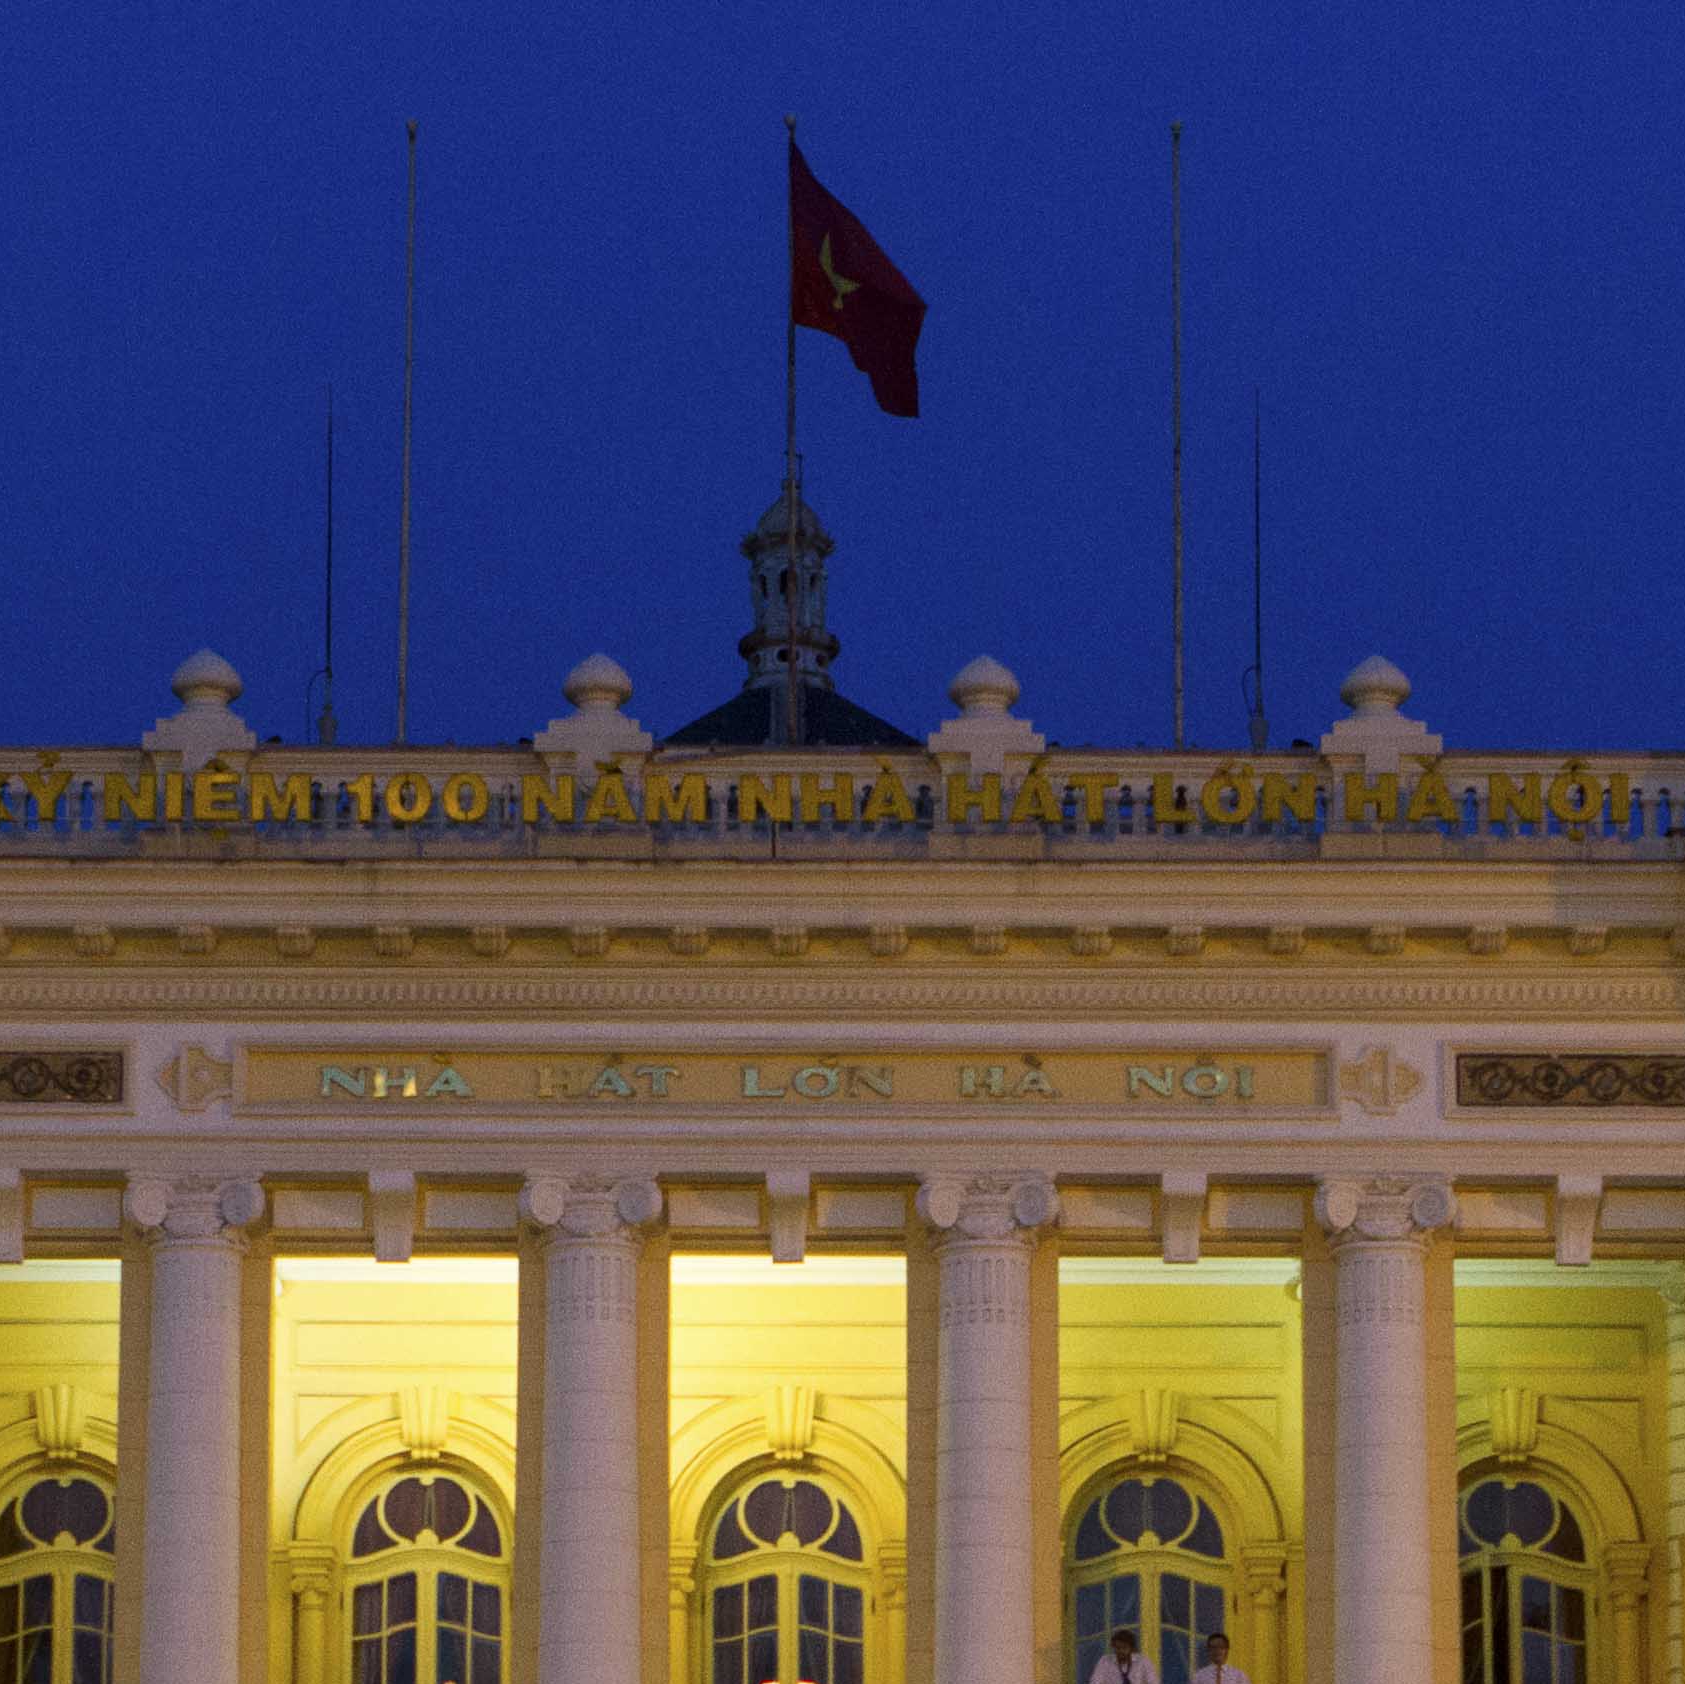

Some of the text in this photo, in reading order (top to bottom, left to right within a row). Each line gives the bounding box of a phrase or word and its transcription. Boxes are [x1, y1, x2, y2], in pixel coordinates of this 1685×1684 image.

[103, 757, 313, 839] NIỆM
[346, 771, 490, 824] 100
[737, 754, 915, 823] NHÀ
[945, 752, 1118, 823] HÁT
[1151, 758, 1317, 824] LỚN
[1344, 755, 1458, 822] HÀ
[1488, 758, 1630, 841] NỘI
[319, 1052, 476, 1098] NHÀ
[958, 1053, 1063, 1098] HÀ
